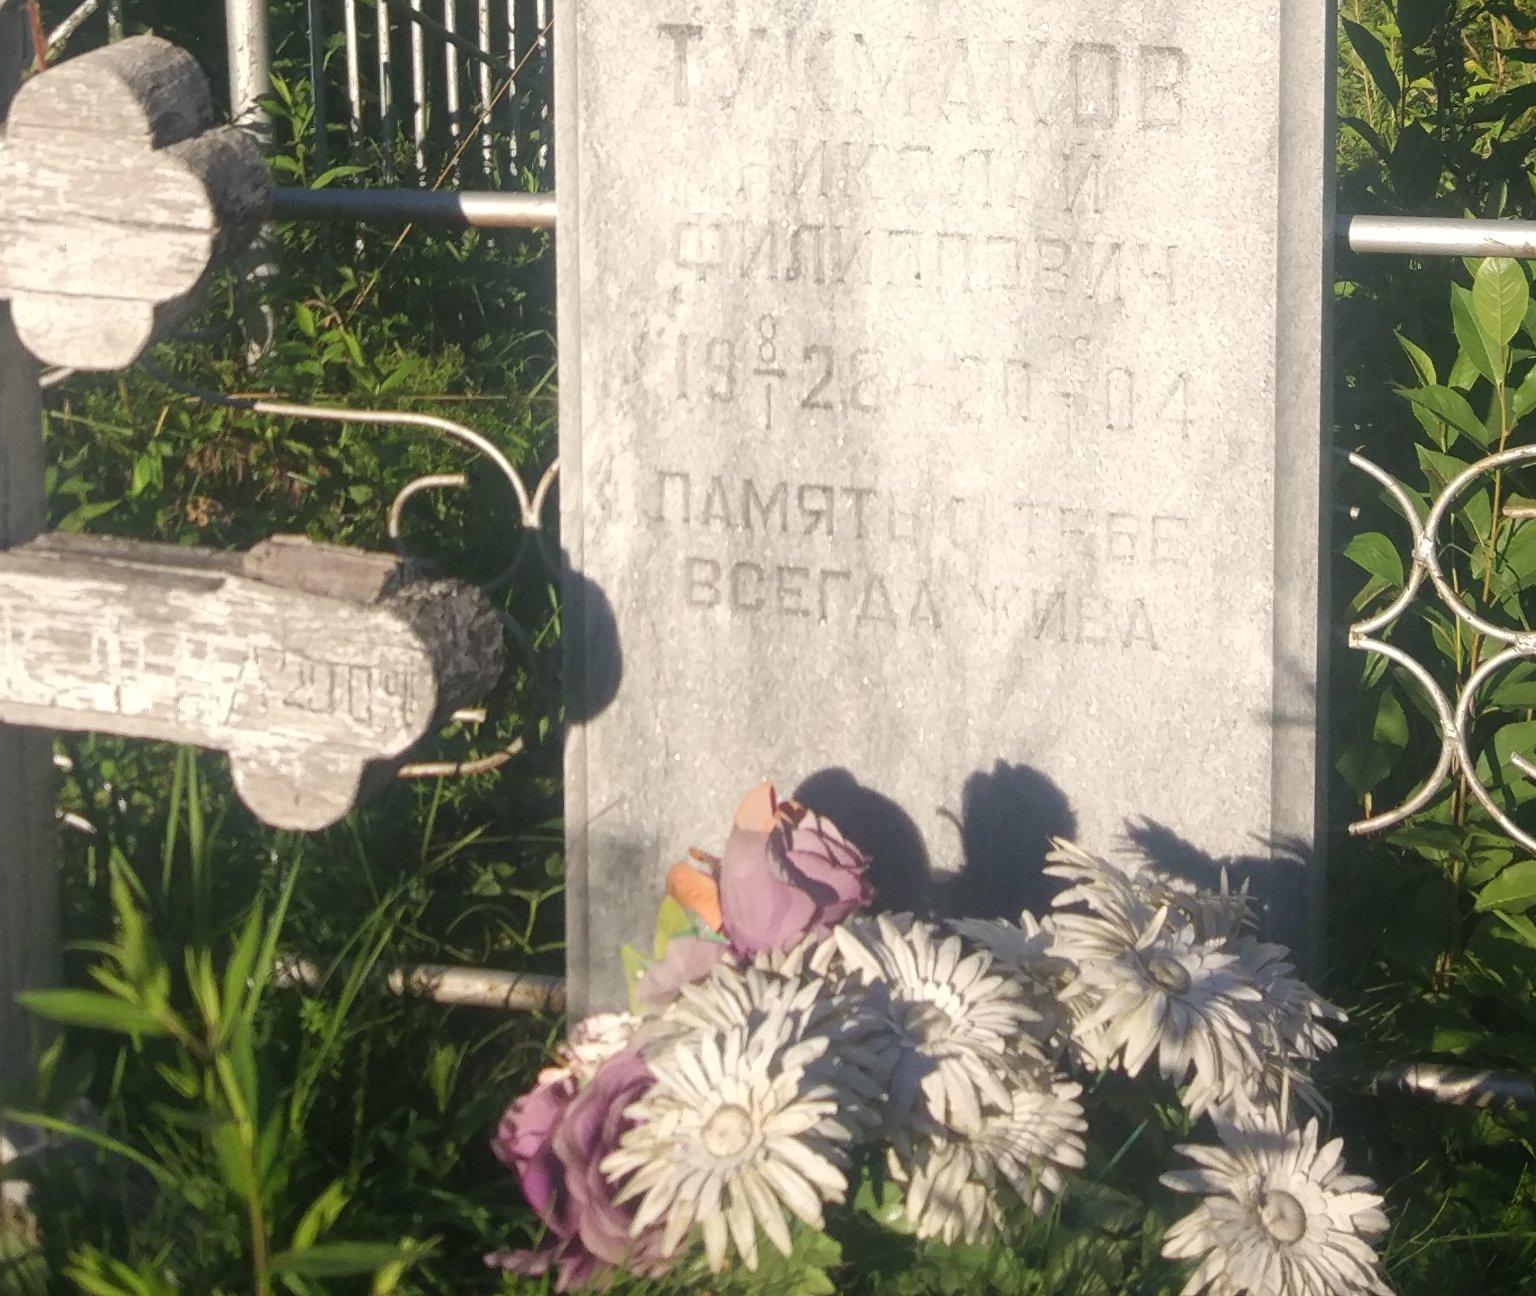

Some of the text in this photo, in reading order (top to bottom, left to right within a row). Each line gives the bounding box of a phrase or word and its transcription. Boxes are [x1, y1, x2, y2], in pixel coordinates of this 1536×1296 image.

[656, 21, 1191, 131] ТУКМАКОВ
[652, 469, 917, 545] ПАМЯТЬ
[683, 556, 944, 636] ВСЕГДА
